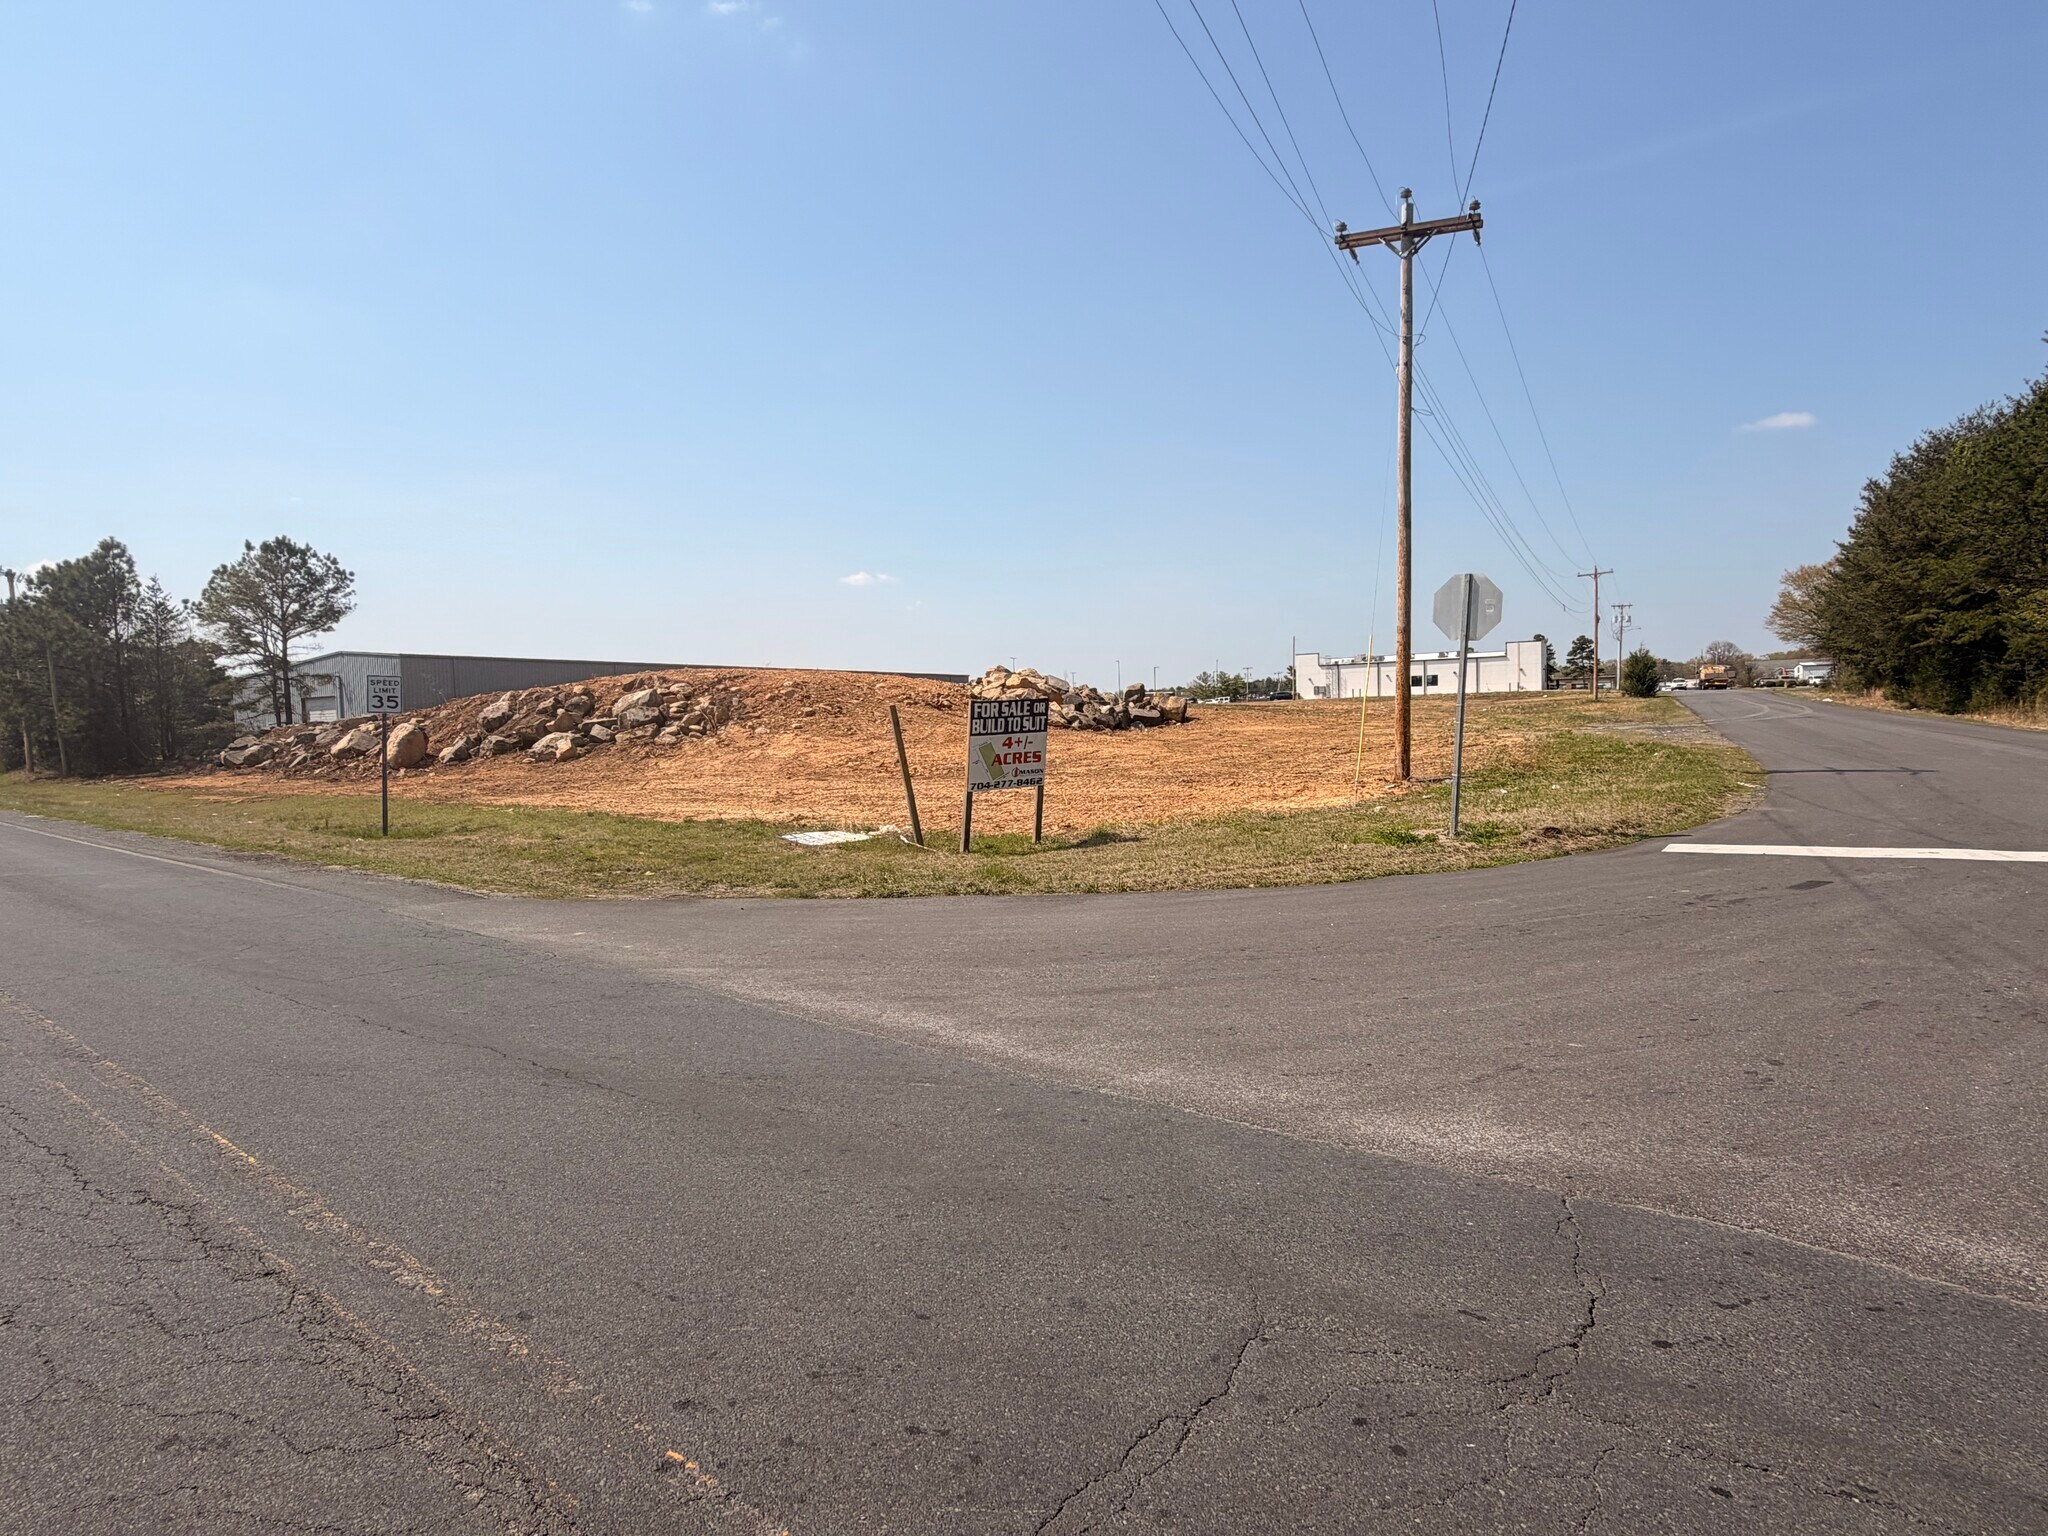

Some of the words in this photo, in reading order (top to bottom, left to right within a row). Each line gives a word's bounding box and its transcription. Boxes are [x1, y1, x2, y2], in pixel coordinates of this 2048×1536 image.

[372, 695, 399, 709] 35
[974, 703, 999, 717] FOR
[1001, 701, 1030, 717] SALE
[1034, 703, 1046, 713] OR
[972, 718, 1005, 733] BUILD
[1007, 717, 1020, 731] TO
[1022, 716, 1047, 730] SUIT
[1002, 736, 1034, 749] 4+/-
[992, 751, 1042, 766] ACRES
[970, 777, 1043, 790] 704-277-8462
